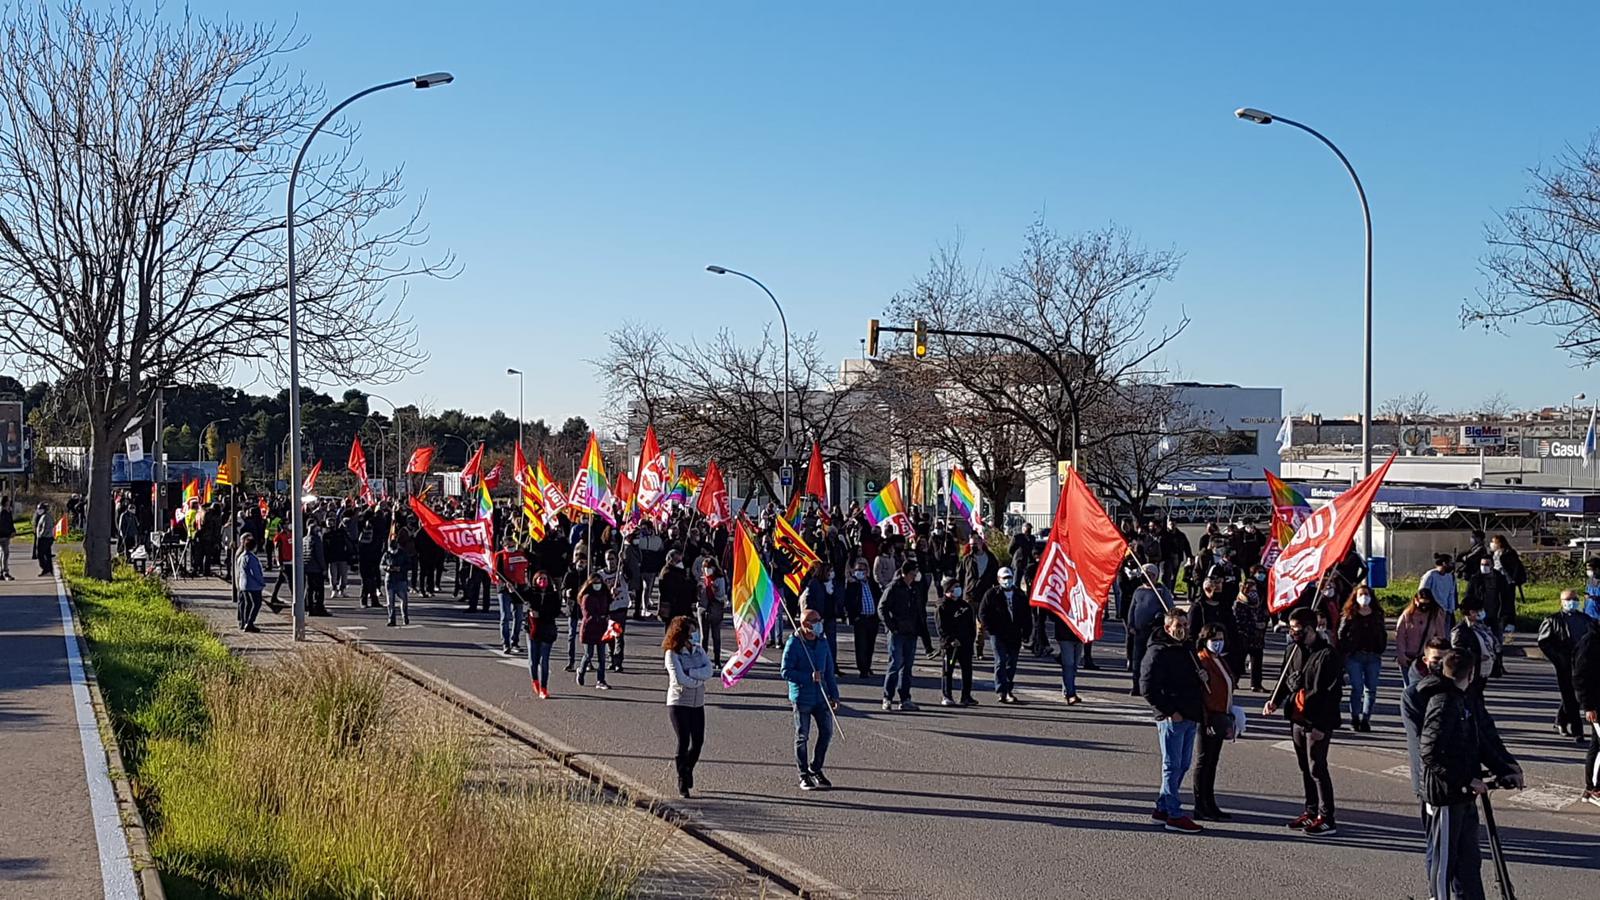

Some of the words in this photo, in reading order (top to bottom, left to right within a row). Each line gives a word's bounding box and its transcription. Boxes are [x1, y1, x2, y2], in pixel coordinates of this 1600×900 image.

[1464, 426, 1501, 436] BigMat
[1541, 497, 1570, 508] 24h/24
[448, 529, 482, 547] UGT
[1045, 557, 1069, 612] UGT
